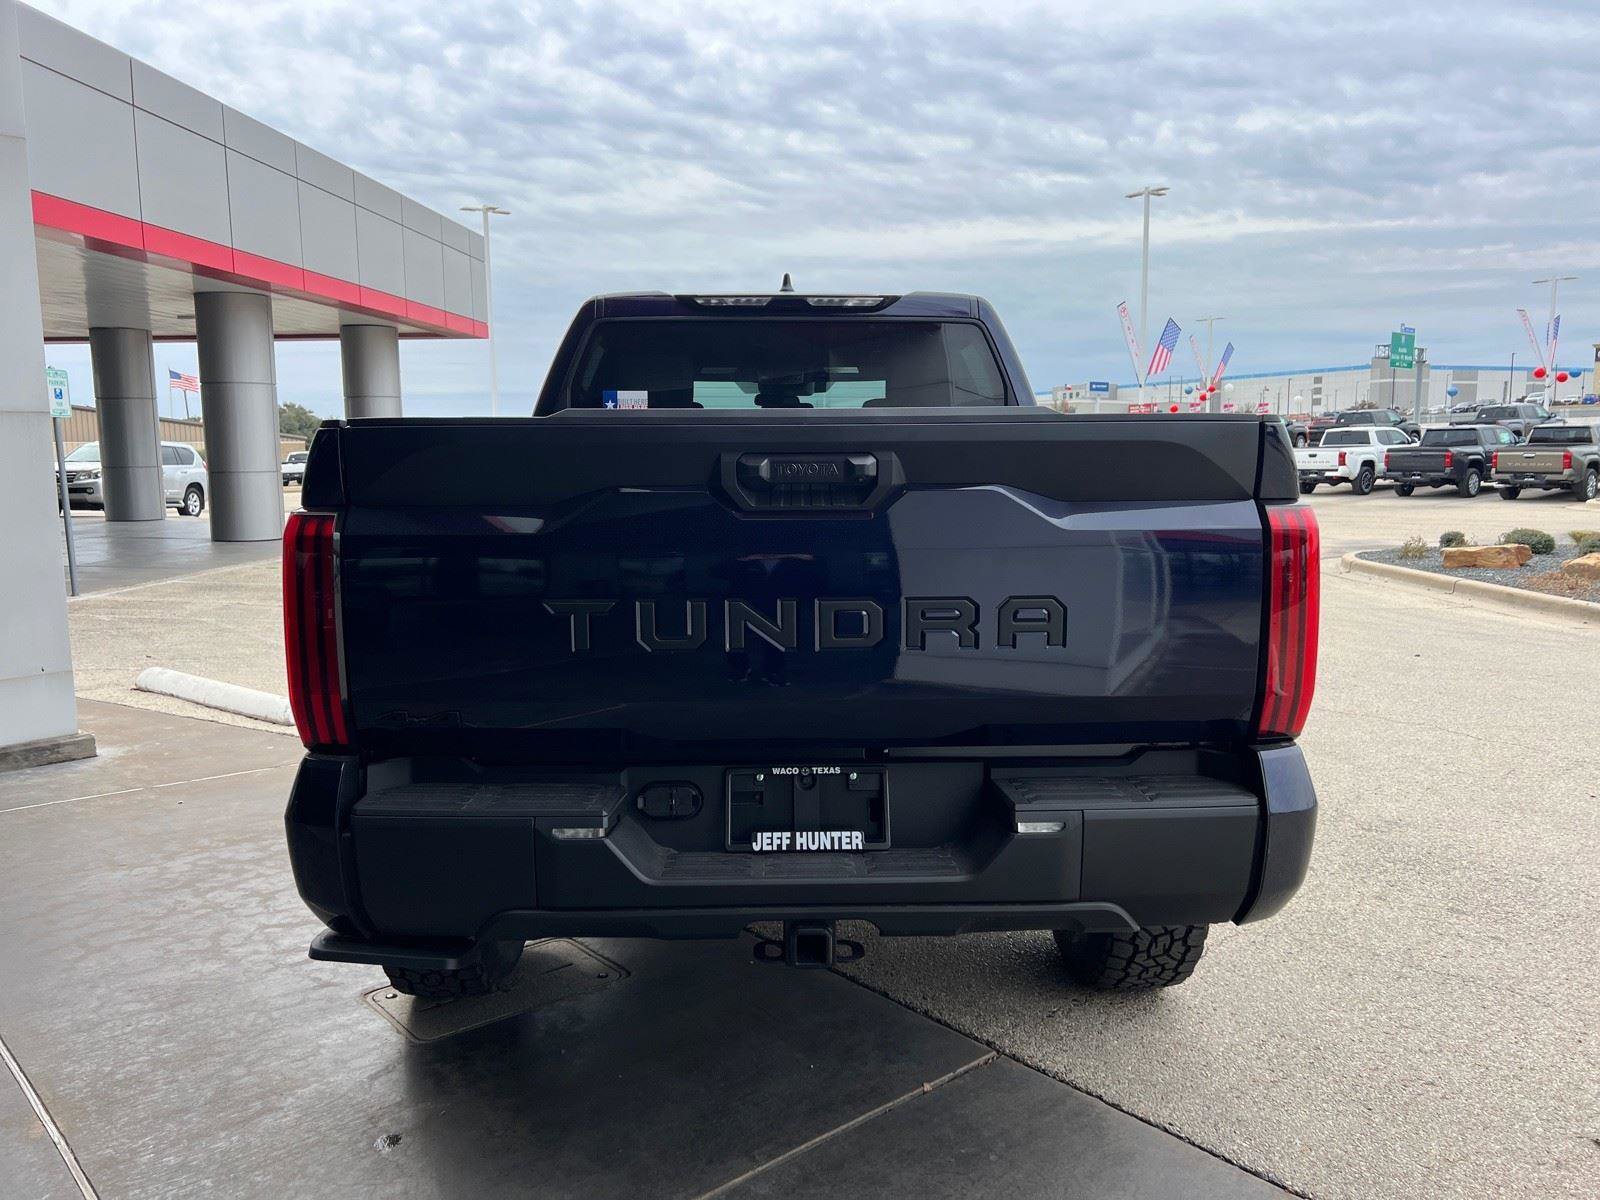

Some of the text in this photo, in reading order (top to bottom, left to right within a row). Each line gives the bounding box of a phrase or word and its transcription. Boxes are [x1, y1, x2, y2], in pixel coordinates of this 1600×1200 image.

[774, 463, 840, 475] TOYOTA
[543, 595, 1067, 653] TUNDRA
[772, 766, 841, 775] WACO TEXAS
[752, 831, 863, 851] JEFF HUNTER
